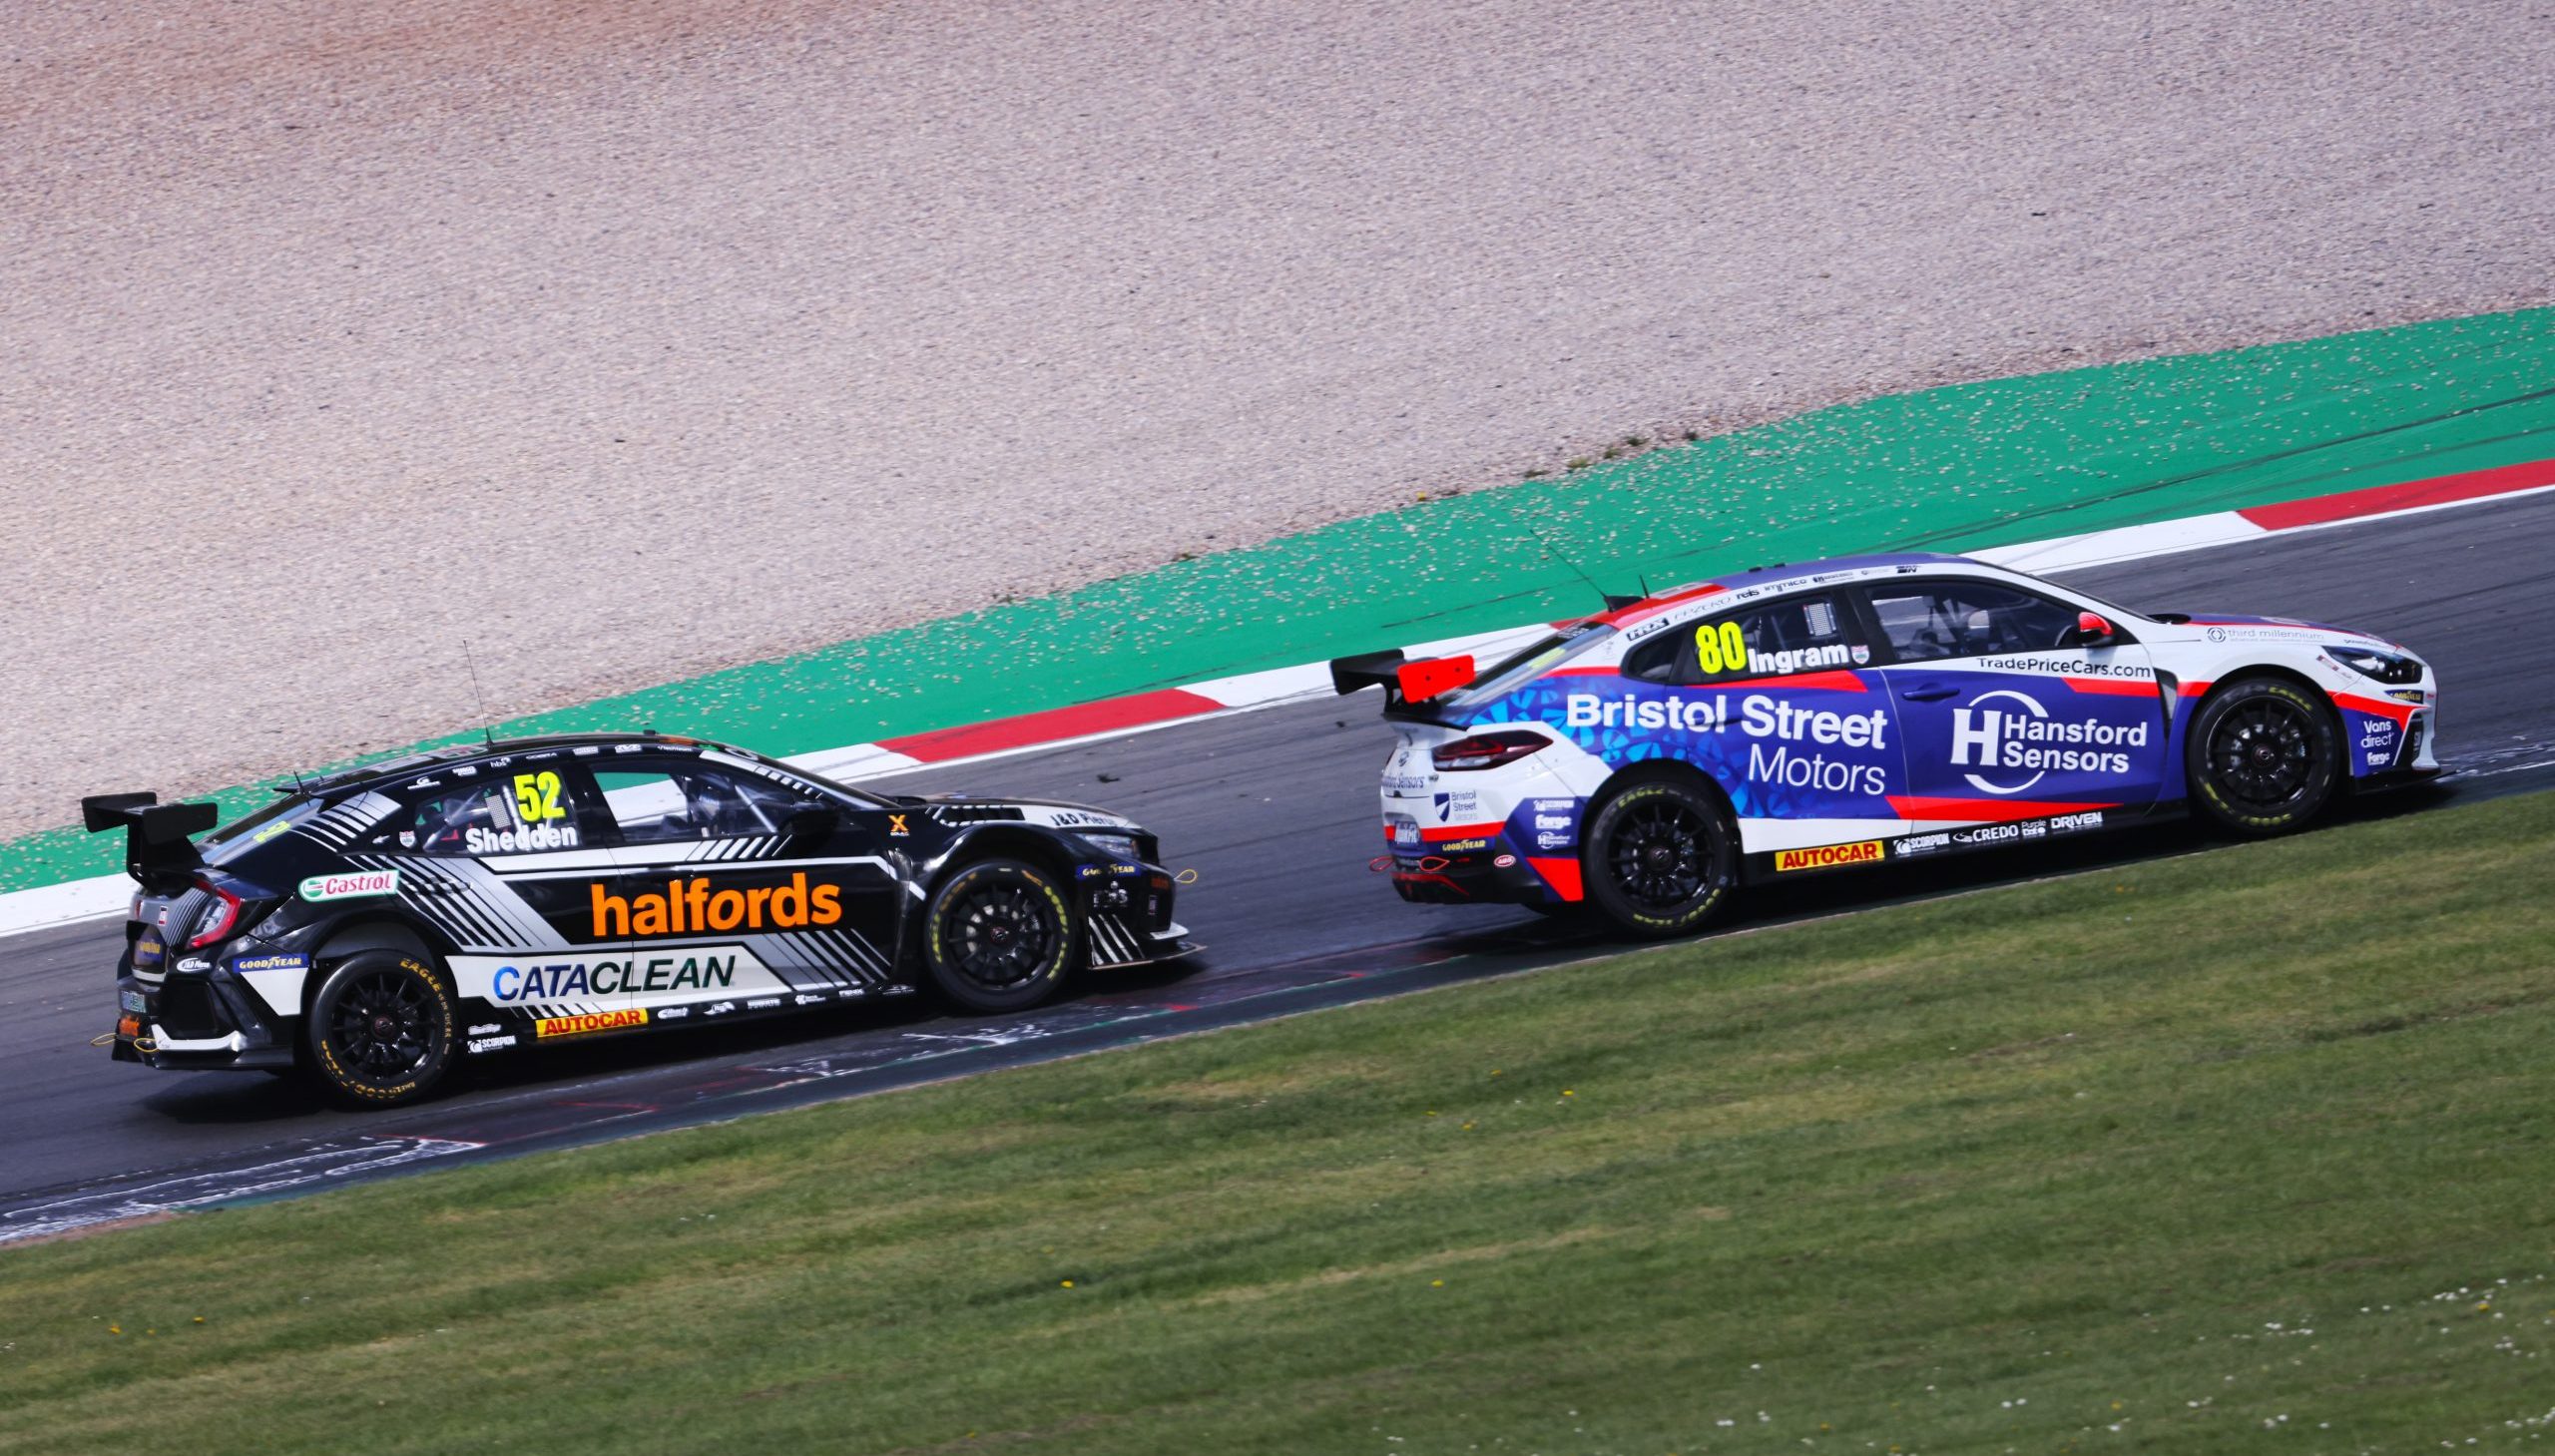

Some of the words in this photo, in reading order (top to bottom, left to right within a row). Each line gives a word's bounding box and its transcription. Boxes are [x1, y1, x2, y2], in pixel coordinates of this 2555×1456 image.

[2228, 629, 2256, 639] third
[1696, 621, 1748, 675] 80
[1749, 644, 1849, 675] Ingram
[1977, 657, 2151, 678] TradePriceCars.com
[1566, 694, 1727, 733] Bristol
[1741, 694, 1888, 749] Street
[2004, 714, 2148, 746] Hansford
[2362, 719, 2392, 734] Vans
[2359, 732, 2392, 749] direct
[1748, 742, 1886, 796] Motors
[2003, 740, 2130, 773] Sensors
[513, 770, 566, 822] 52
[1451, 789, 1477, 801] Bristol
[1453, 801, 1477, 811] Street
[1972, 824, 2019, 842] CREDO
[2050, 811, 2104, 829] DRIVEN
[465, 823, 579, 854] Shedden
[1783, 842, 1877, 870] AUTOCAR
[325, 872, 391, 896] Castrol
[591, 872, 841, 938] halfords
[239, 956, 302, 970] GOODYEAR
[493, 955, 736, 1001] CATACLEAN
[544, 1010, 641, 1036] AUTOCAR
[481, 1035, 517, 1048] SCORPION
